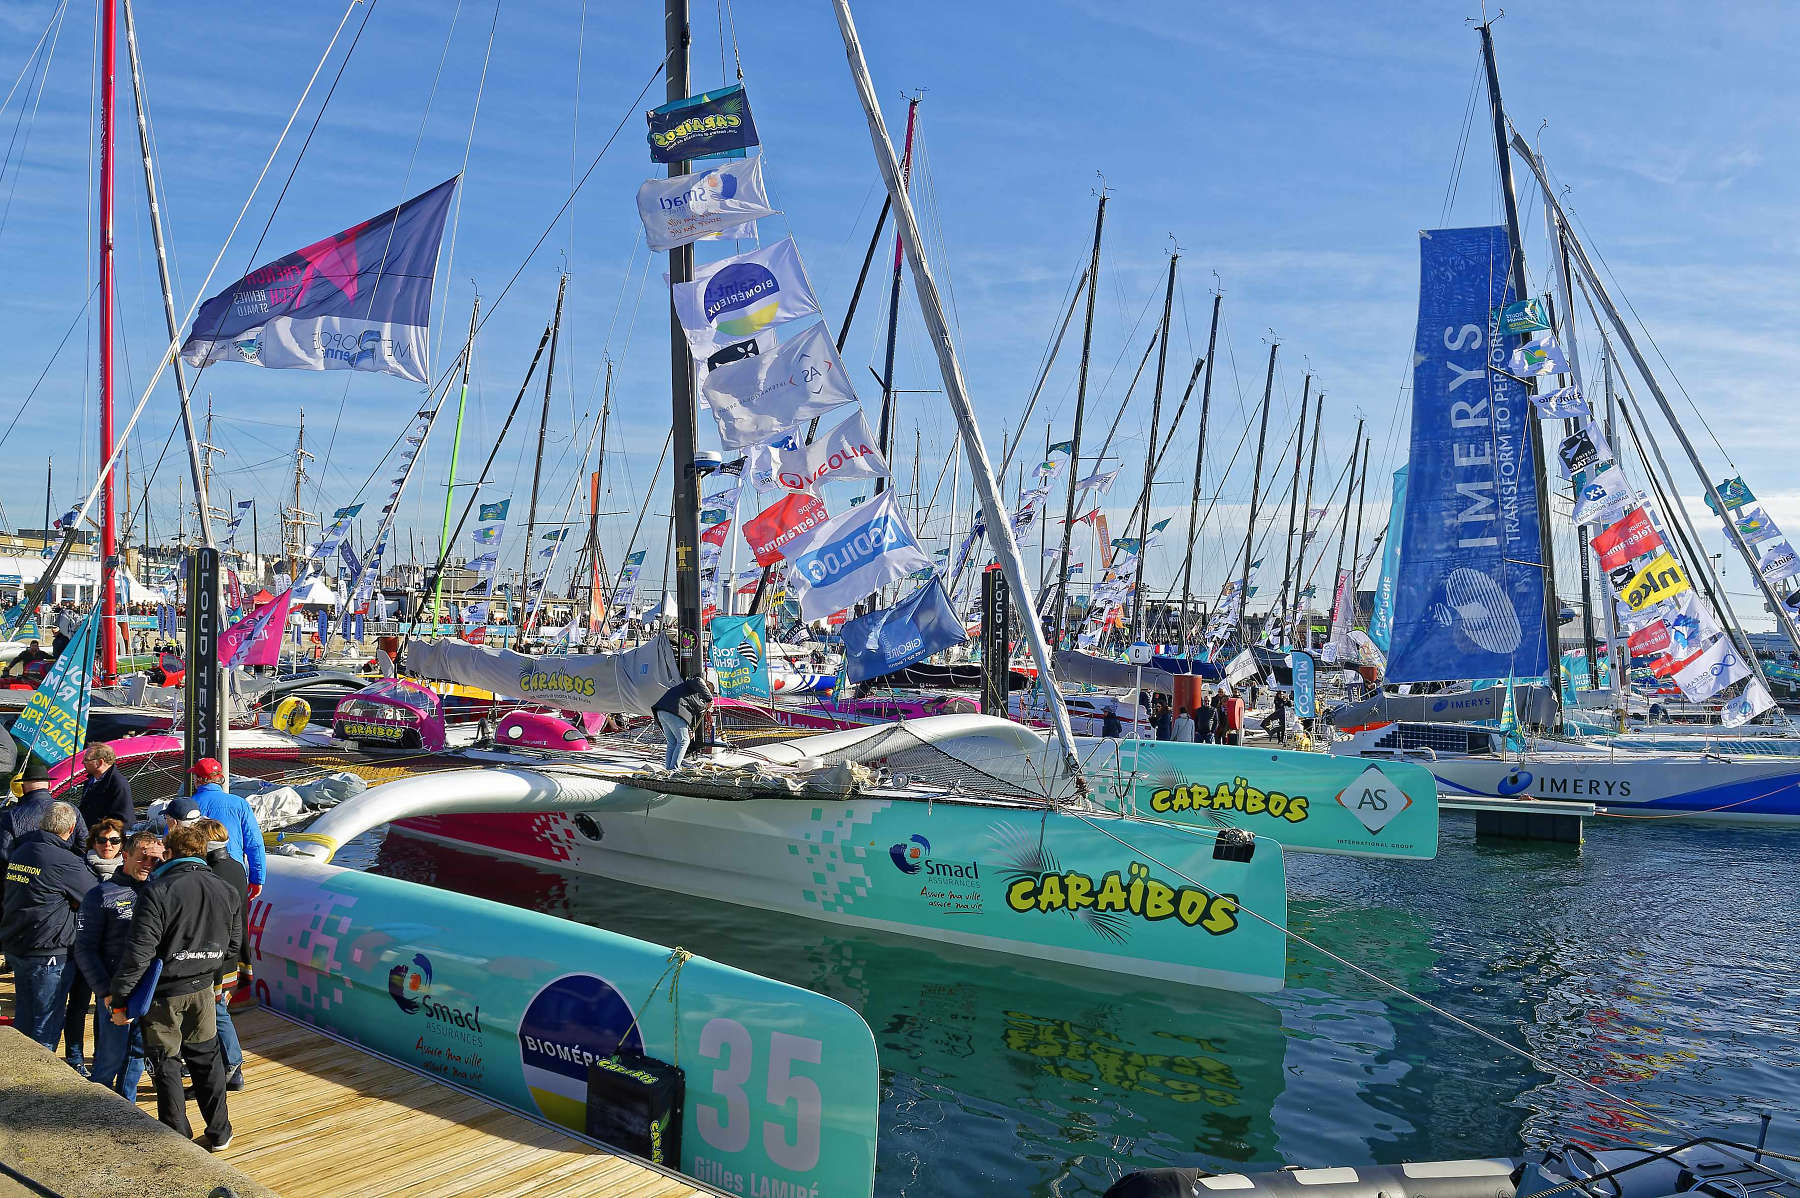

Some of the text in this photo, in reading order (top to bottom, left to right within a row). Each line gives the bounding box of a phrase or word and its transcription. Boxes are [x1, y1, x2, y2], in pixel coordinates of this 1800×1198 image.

[1444, 323, 1498, 548] IMERYS
[1490, 319, 1521, 545] TRANSFORM TO PERFORM
[804, 443, 874, 485] VEOLIA
[995, 569, 1003, 624] CLOUD
[198, 550, 210, 757] CLOUD TEMP
[1135, 649, 1140, 658] C
[1451, 697, 1491, 709] IMERYS
[1150, 776, 1309, 823] CARAÏBOS
[1357, 788, 1388, 811] AS
[1540, 777, 1631, 797] IMERYS
[1337, 839, 1388, 849] INTERNATIONAL
[925, 860, 979, 879] Smacl
[928, 876, 981, 889] ASSURANCES
[1006, 860, 1240, 936] CARAÏBOS
[422, 994, 482, 1033] Smacl
[426, 1021, 484, 1049] ASSURANCES
[696, 1018, 823, 1172] 35
[694, 1156, 744, 1194] Gilles
